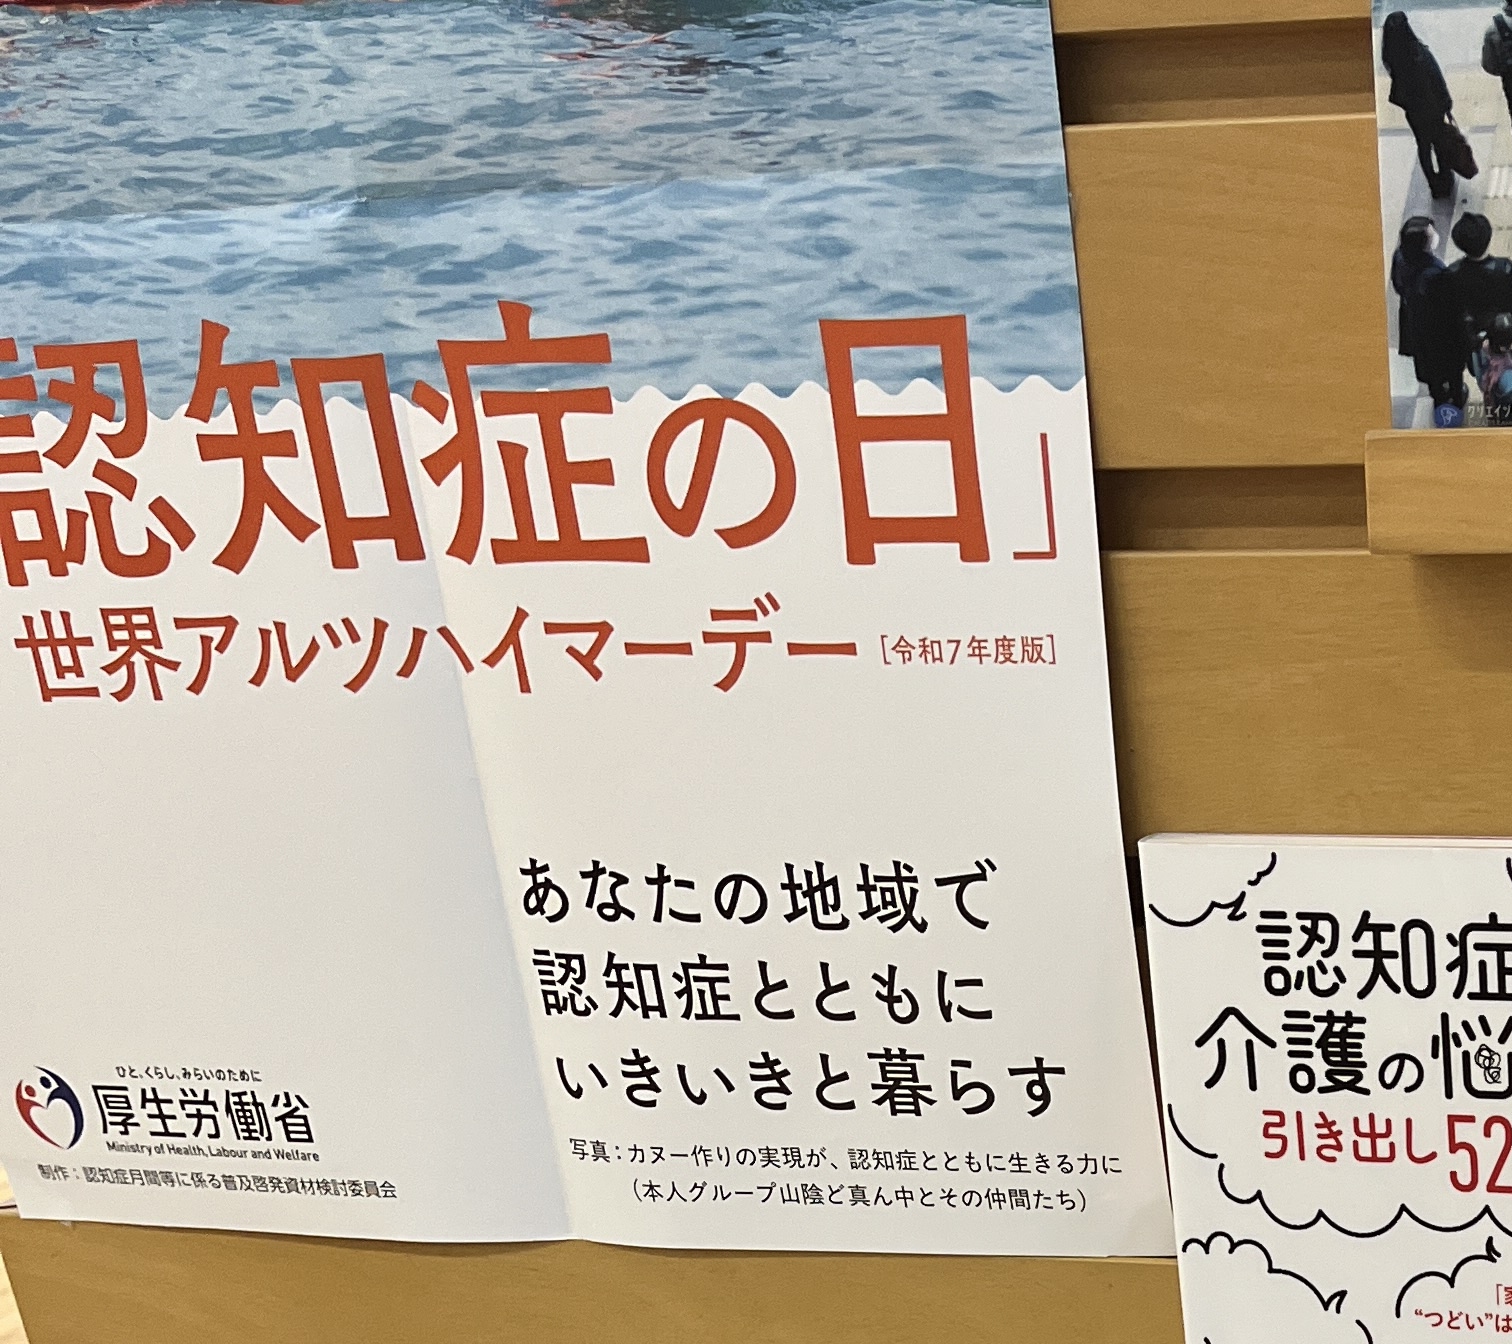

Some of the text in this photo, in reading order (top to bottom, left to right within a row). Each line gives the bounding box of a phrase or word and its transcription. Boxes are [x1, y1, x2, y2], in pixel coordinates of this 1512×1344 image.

[13, 591, 860, 705] 世界アルツハイマーデー
[518, 856, 999, 935] あなたの地域で
[532, 947, 995, 1025] 認知症とともに
[92, 1084, 315, 1144] 厚生労働省
[552, 1047, 1069, 1120] いきいきと暮らす
[107, 1141, 153, 1158] Ministry
[209, 1146, 248, 1160] Labour
[251, 1148, 272, 1160] and
[274, 1149, 319, 1162] Welfare
